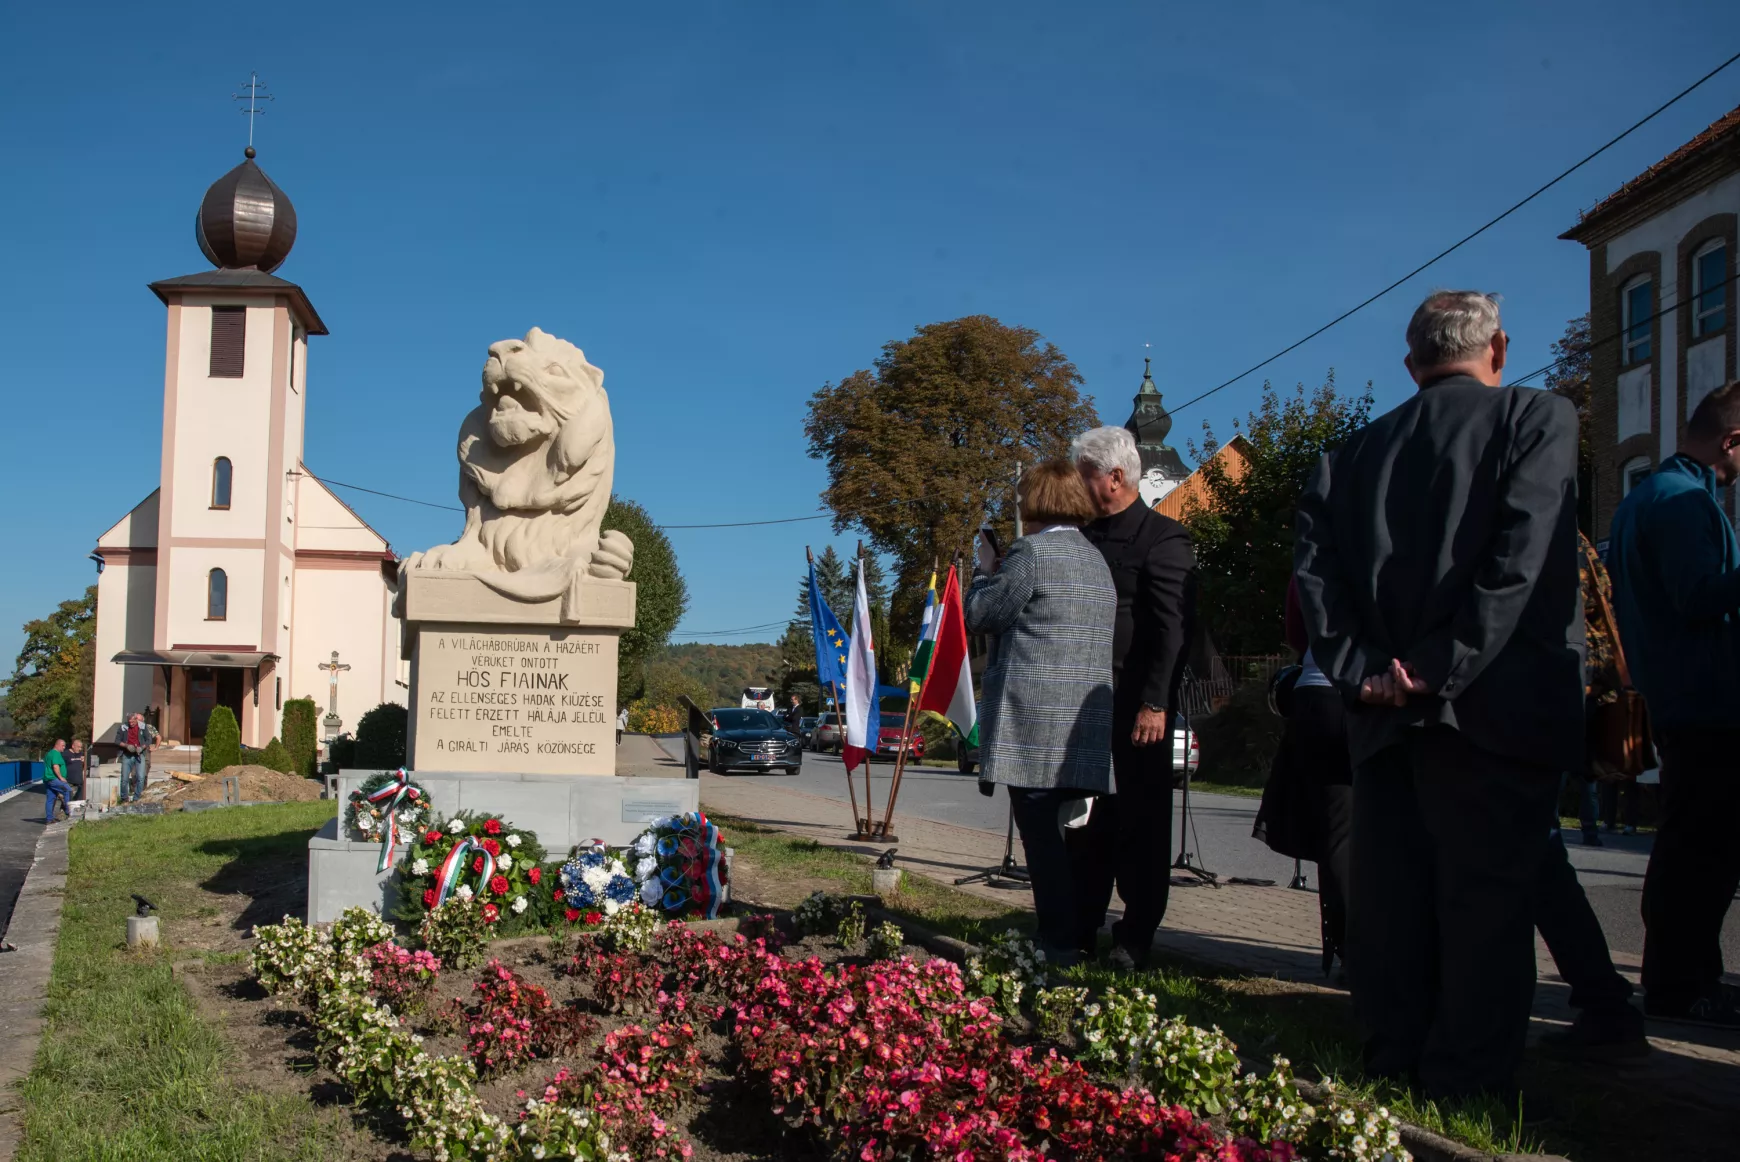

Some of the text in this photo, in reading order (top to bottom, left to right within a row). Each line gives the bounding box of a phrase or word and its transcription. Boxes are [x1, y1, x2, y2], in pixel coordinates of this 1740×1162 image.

[439, 638, 445, 649] A
[543, 642, 551, 653] A
[556, 640, 601, 654] HAZÁÉRT
[521, 657, 559, 669] ONTOTT
[500, 671, 570, 691] FIAINAK
[431, 691, 445, 703] AZ
[450, 689, 517, 705] ELLENSÉGES
[523, 693, 556, 706] HADAK
[430, 707, 471, 720] FELETT
[527, 707, 567, 724] HÁLÁJA
[492, 725, 534, 738] EMELTE
[436, 738, 444, 750] A
[497, 738, 530, 754] JÁRÁS
